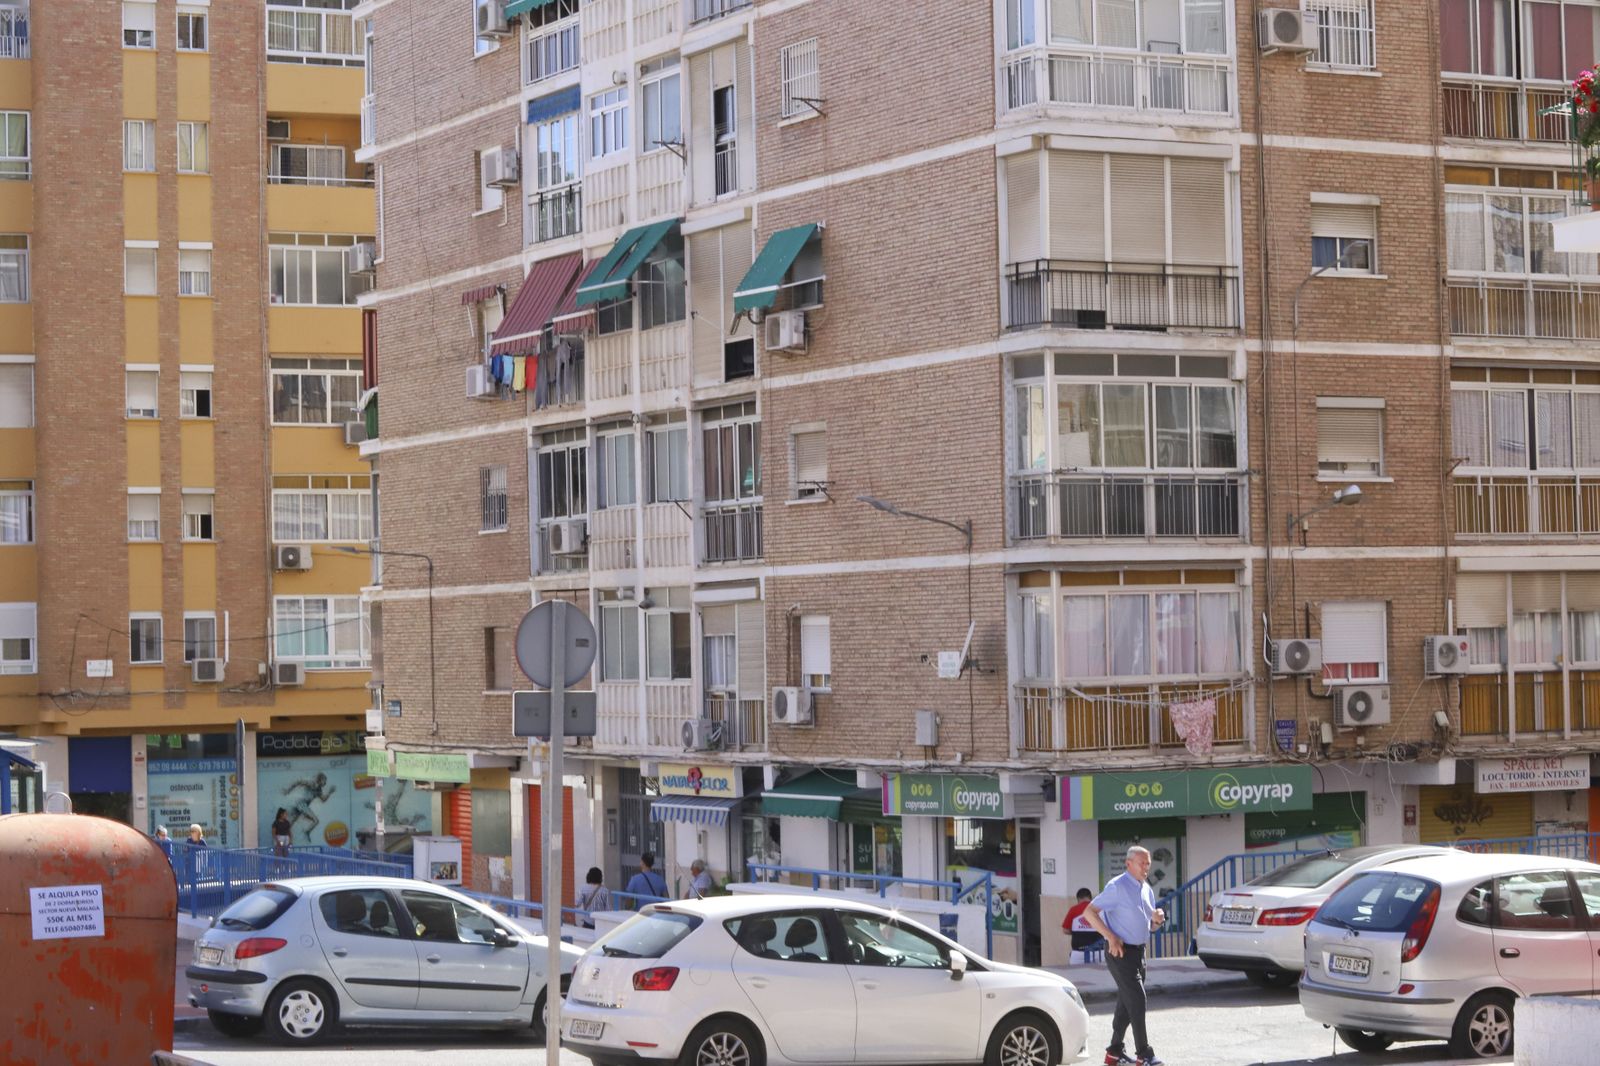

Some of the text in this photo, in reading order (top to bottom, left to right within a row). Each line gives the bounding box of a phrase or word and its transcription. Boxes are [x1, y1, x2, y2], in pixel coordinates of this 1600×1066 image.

[1503, 755, 1566, 771] SPACE NET
[1481, 771, 1536, 782] LOCUTORIO
[1543, 769, 1587, 779] INTERNET
[1220, 783, 1293, 805] copyrap
[905, 800, 939, 812] copyrap.com
[956, 791, 1000, 811] copyrap
[1114, 800, 1174, 813] copyrap.com
[48, 890, 80, 899] ALQUILA
[81, 888, 99, 897] PISO
